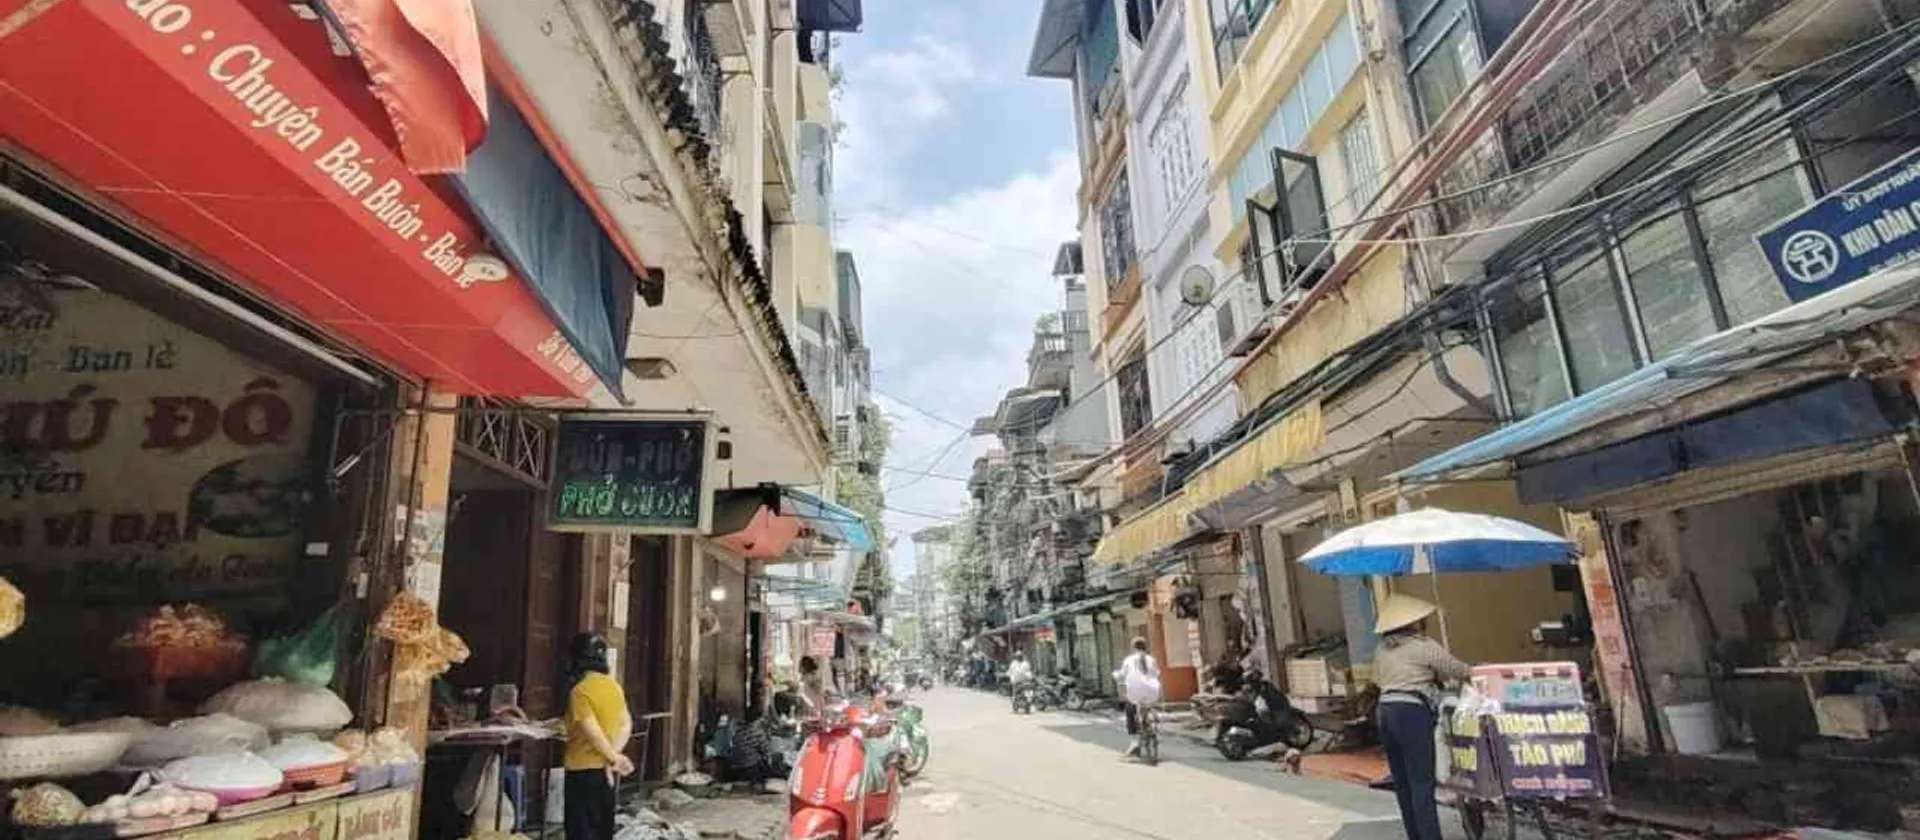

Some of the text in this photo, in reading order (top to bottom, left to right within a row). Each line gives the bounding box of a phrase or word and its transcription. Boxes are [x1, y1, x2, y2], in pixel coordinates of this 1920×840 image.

[208, 43, 324, 152] Chuyên
[314, 137, 374, 196] Bán
[361, 178, 424, 240] Buôn
[422, 232, 468, 276] Bán
[1840, 223, 1880, 258] KHU
[1873, 206, 1917, 244] DÂN
[141, 376, 292, 452] ĐÔ
[559, 473, 619, 518] PHỞ
[1509, 739, 1549, 766] TÀO
